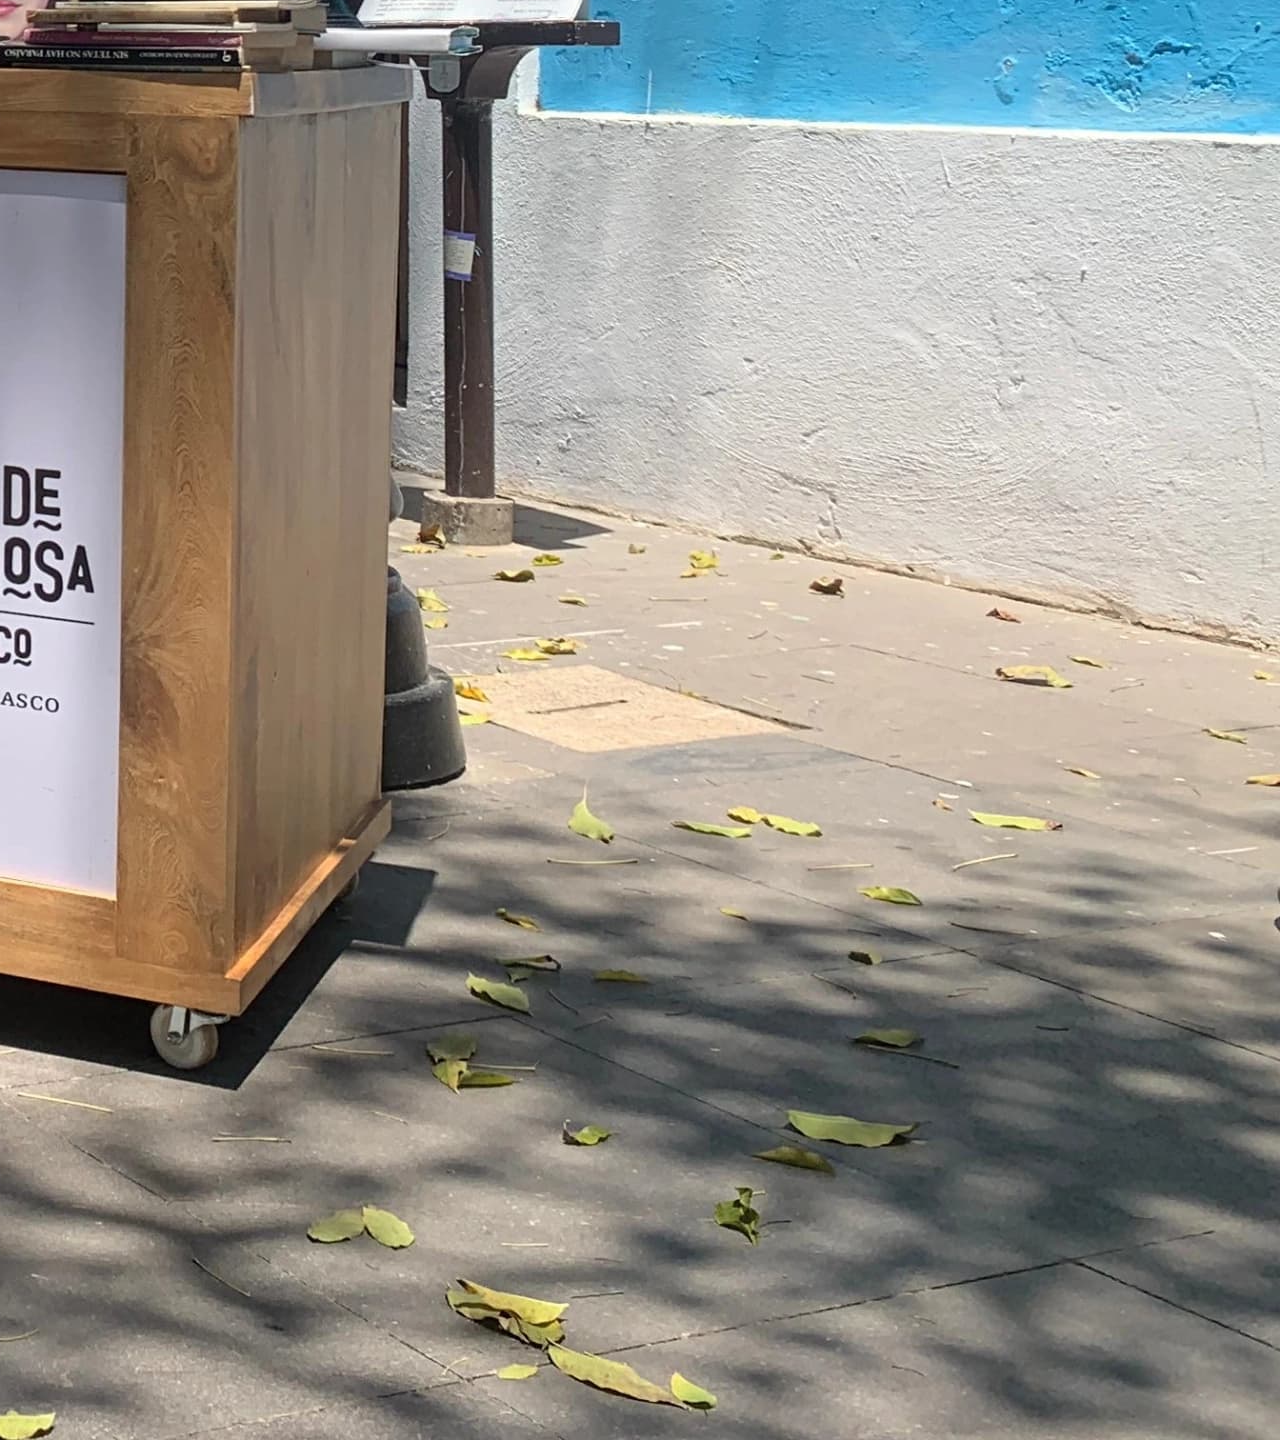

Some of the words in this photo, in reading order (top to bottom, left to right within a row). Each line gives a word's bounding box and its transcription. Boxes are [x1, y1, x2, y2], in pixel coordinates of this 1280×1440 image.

[4, 47, 44, 59] PARAÍSO
[45, 48, 65, 58] HAY
[65, 49, 81, 58] NO
[82, 49, 110, 59] TETAS
[112, 50, 128, 59] SIN
[2, 465, 62, 532] DE
